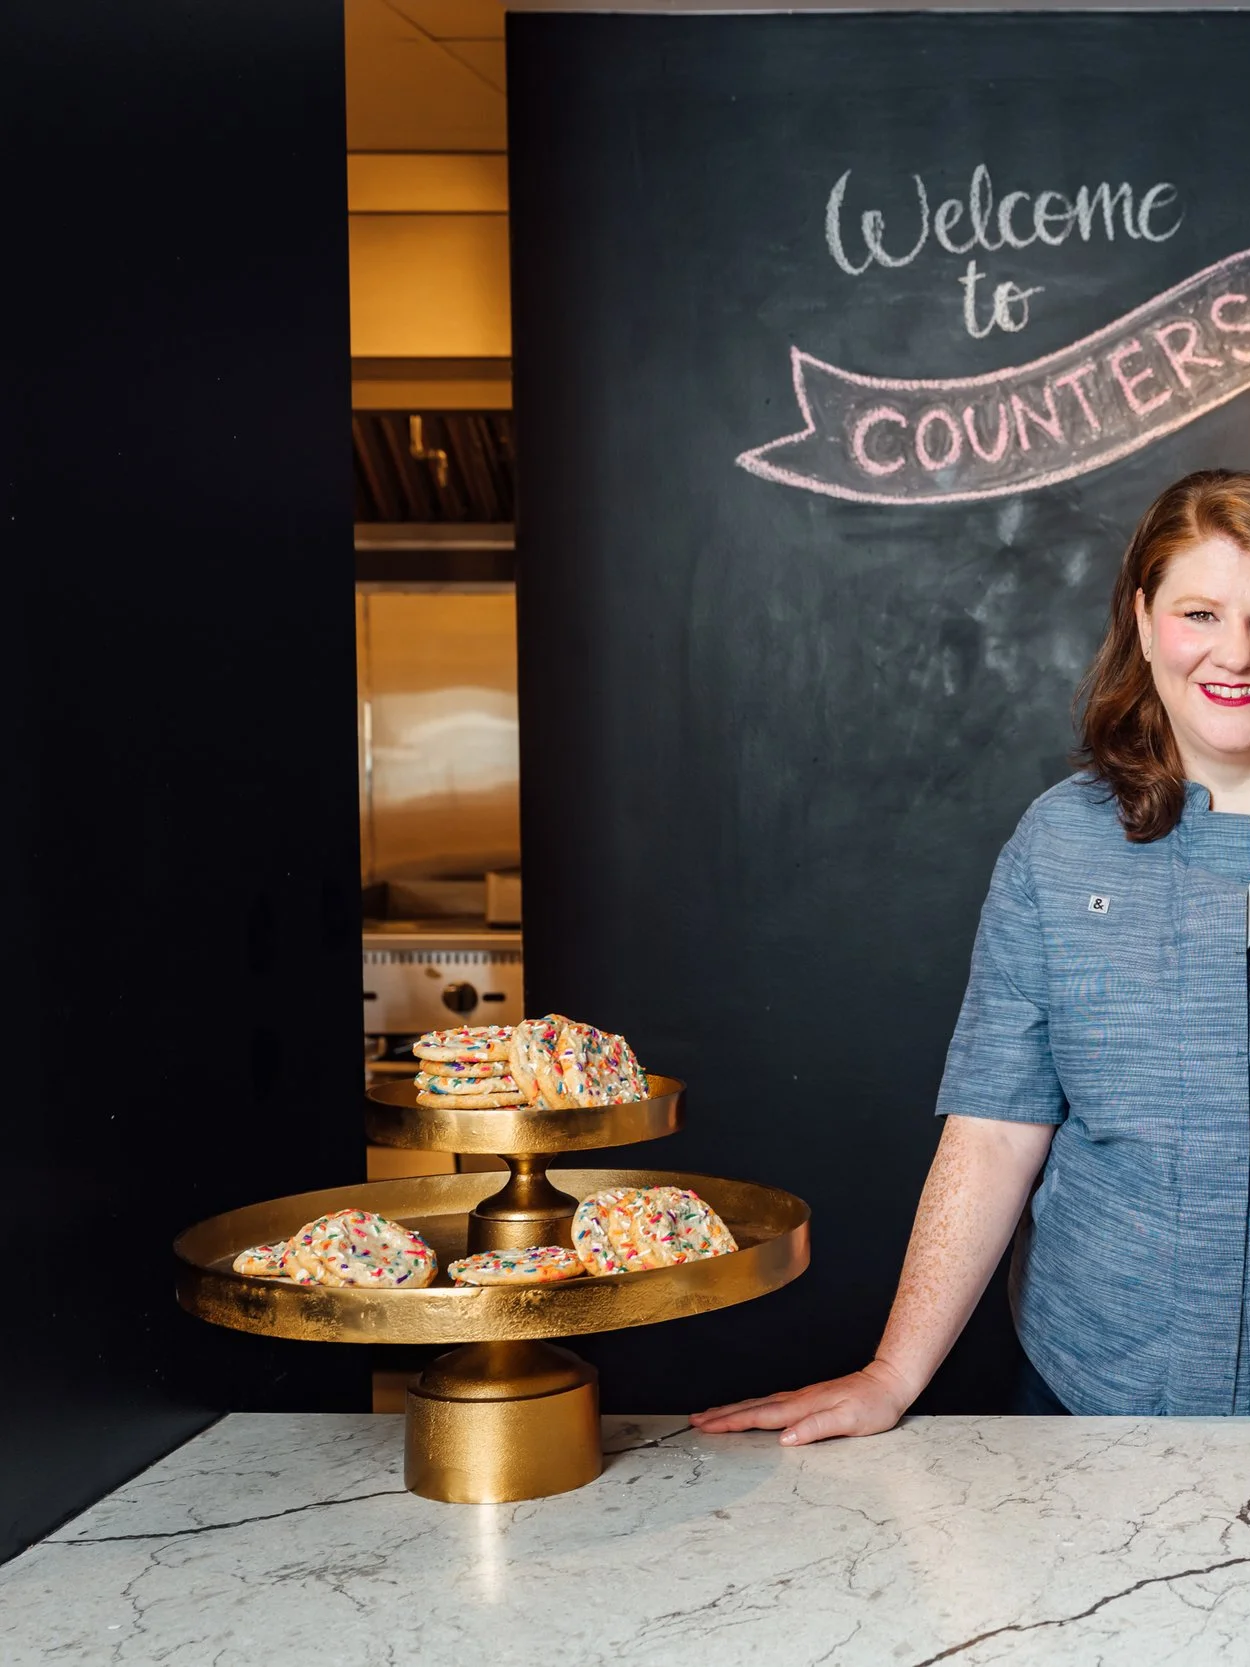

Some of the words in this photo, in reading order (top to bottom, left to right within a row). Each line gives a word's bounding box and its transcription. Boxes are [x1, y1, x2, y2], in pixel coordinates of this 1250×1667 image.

[824, 163, 1184, 276] Welcome
[958, 259, 1045, 338] to
[1093, 898, 1104, 910] &
